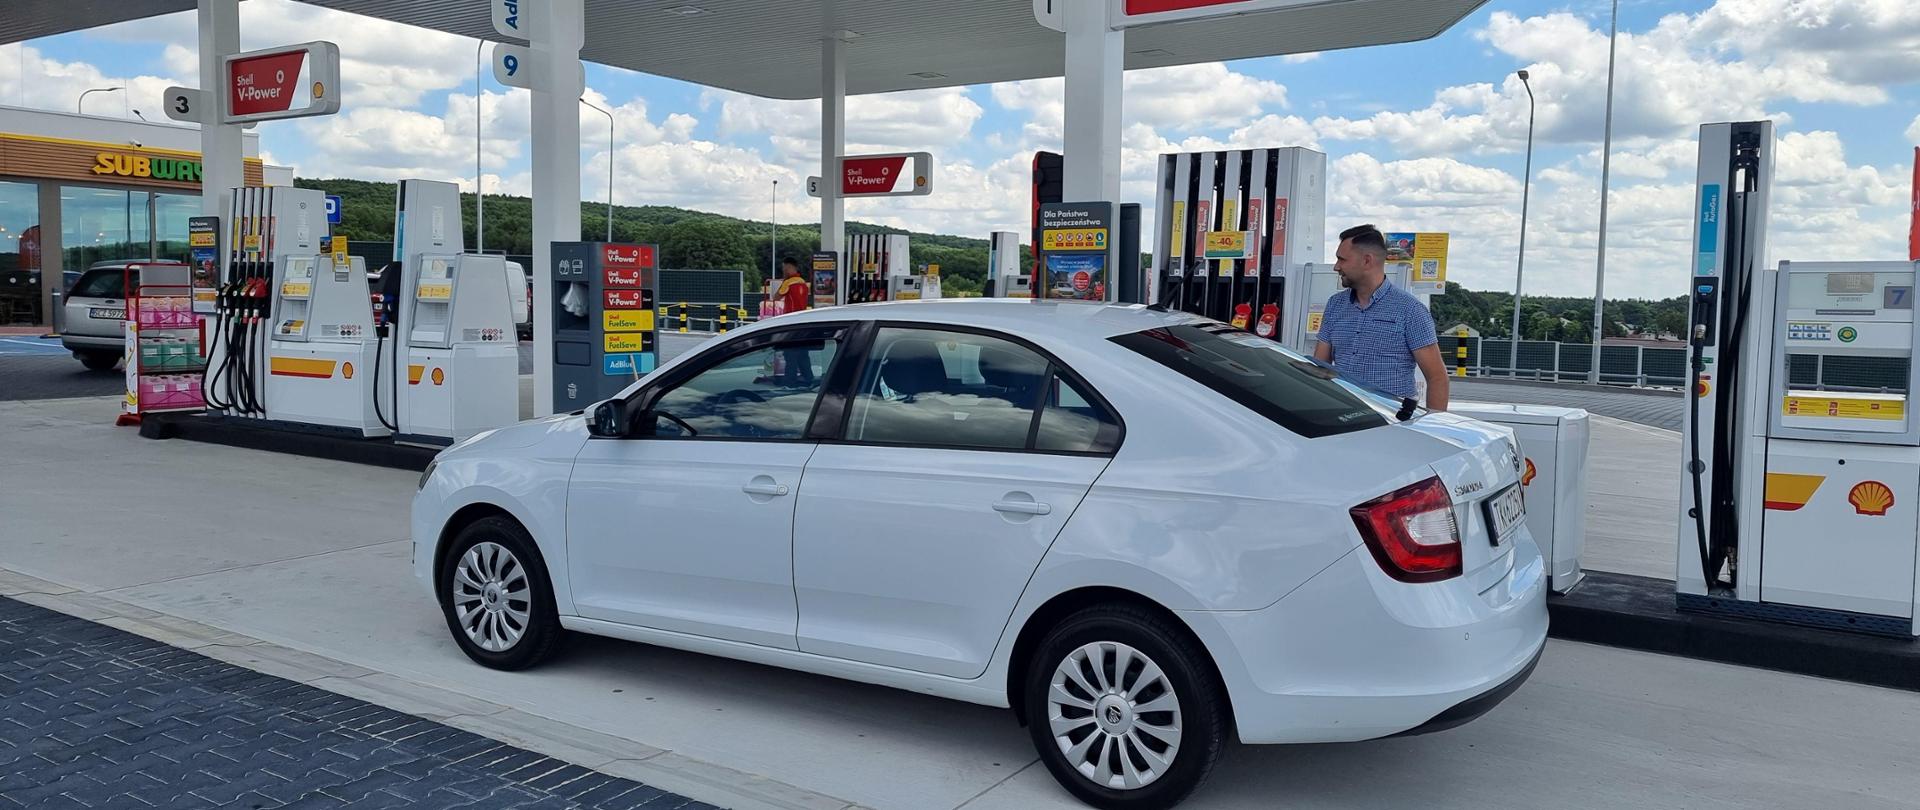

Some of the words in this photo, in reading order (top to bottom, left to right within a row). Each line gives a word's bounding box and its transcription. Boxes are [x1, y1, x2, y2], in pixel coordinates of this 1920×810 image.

[504, 0, 518, 30] Ad
[503, 54, 519, 77] 9
[236, 75, 254, 86] Shell
[237, 86, 281, 101] V-Power
[175, 96, 190, 114] 3
[847, 168, 863, 176] Shell
[848, 176, 886, 185] V-Power
[810, 182, 817, 192] 5
[1057, 210, 1089, 218] Państwa
[1043, 219, 1101, 228] bezpieczeństwa
[607, 255, 636, 263] V-Power
[608, 277, 637, 285] V-Power
[1891, 289, 1906, 305] 7
[608, 298, 637, 306] V-Power
[608, 319, 637, 327] FuelSave
[608, 341, 637, 349] FuelSave
